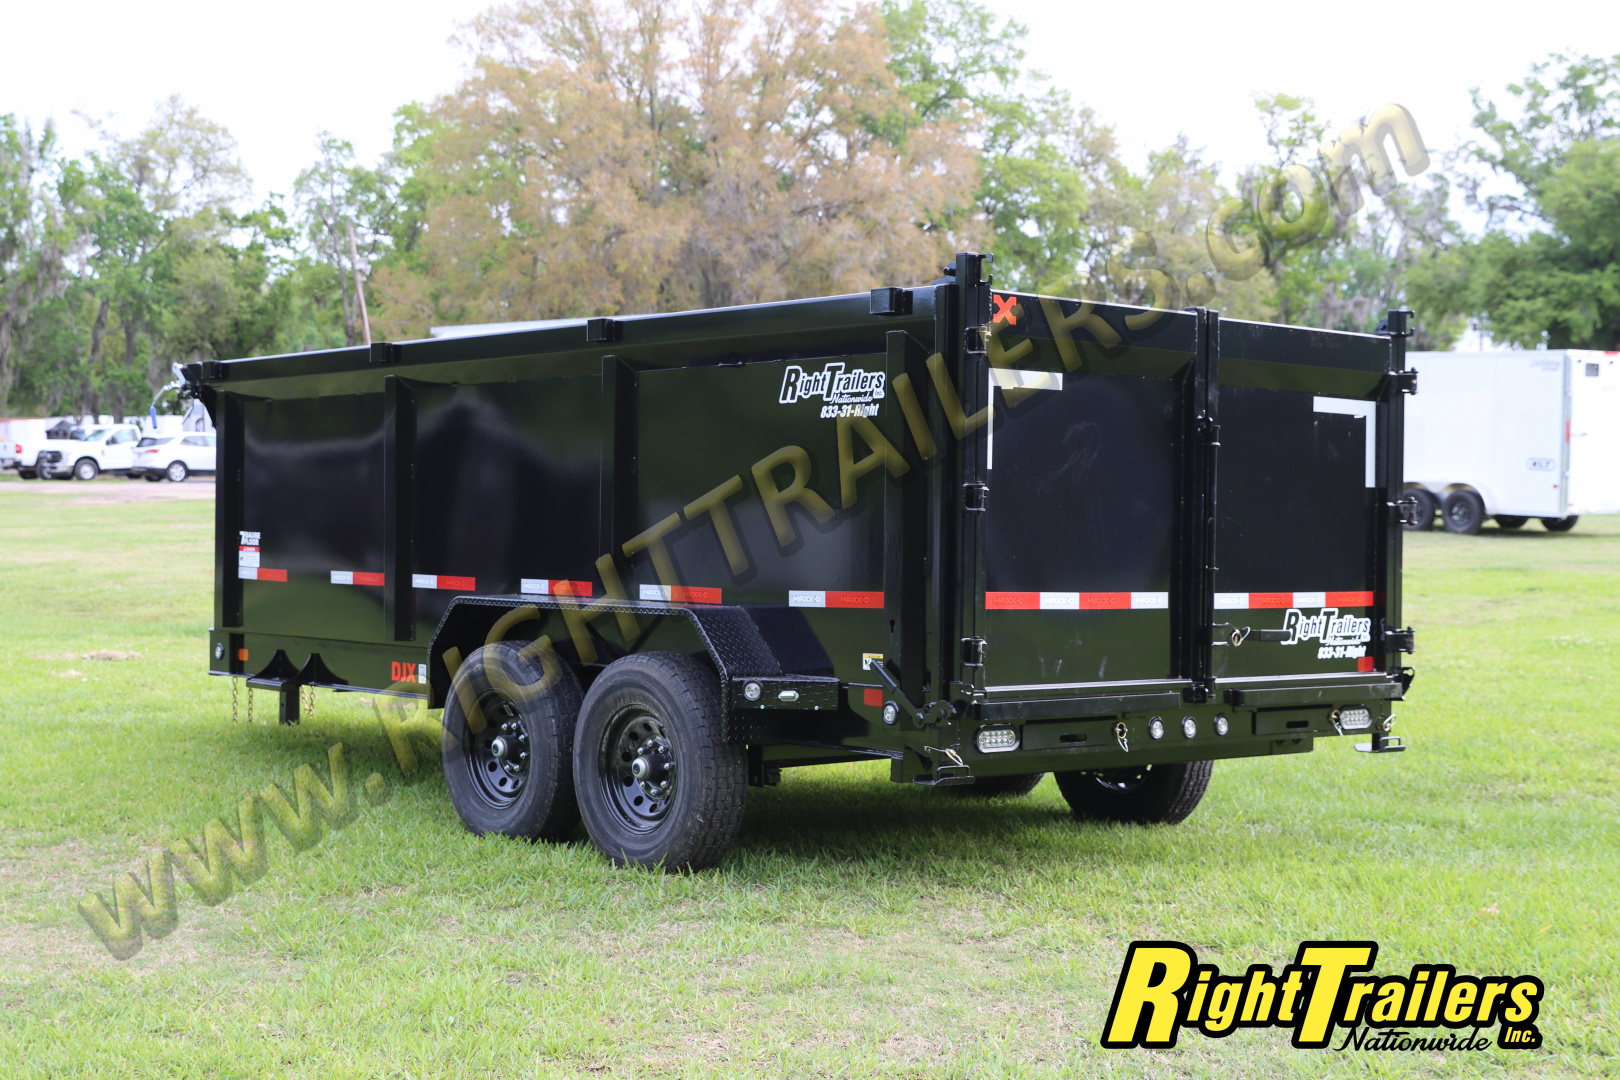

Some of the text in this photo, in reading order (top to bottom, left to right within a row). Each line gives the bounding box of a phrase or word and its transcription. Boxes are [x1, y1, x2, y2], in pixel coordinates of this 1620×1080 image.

[830, 392, 873, 404] Nationwide
[820, 403, 880, 418] 833-31-Right
[793, 595, 870, 604] MAXX-D MAXX-D
[993, 596, 1024, 605] MAXX-D
[1044, 596, 1074, 605] MAXX-D
[1087, 597, 1116, 605] MAXX-D
[391, 661, 417, 683] DJX
